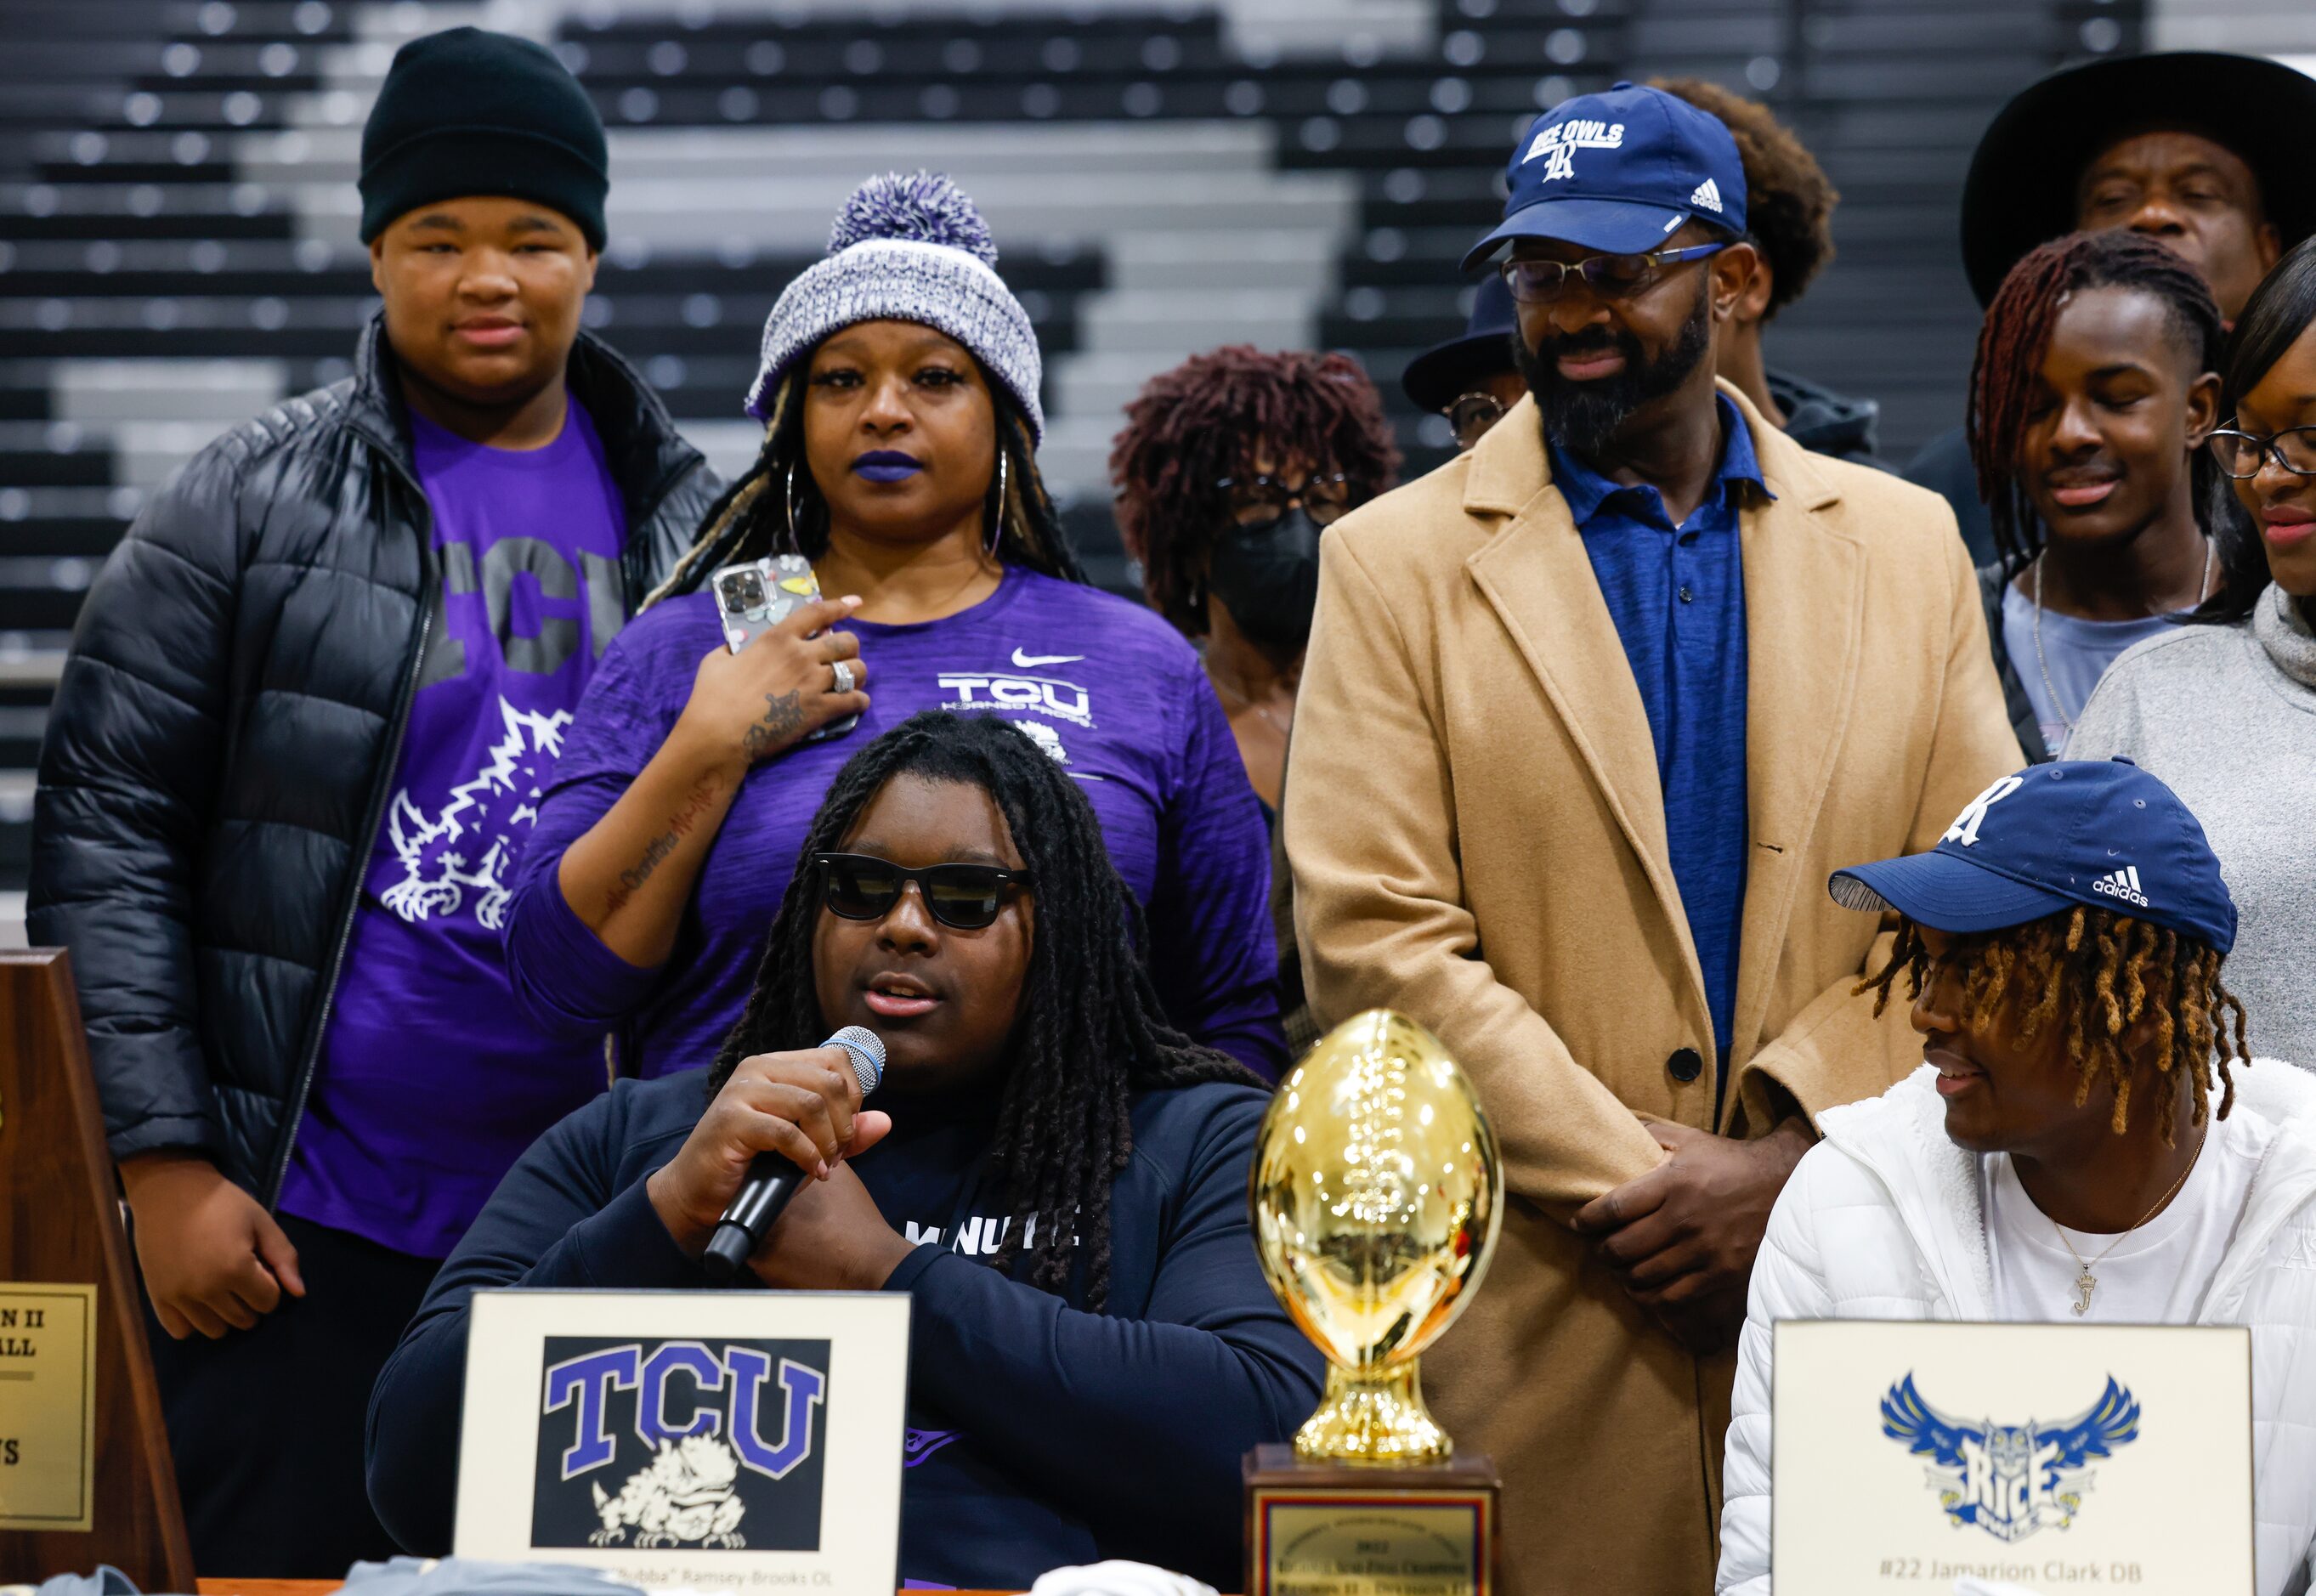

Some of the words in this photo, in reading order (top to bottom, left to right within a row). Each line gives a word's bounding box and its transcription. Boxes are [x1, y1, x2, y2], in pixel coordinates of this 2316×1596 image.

[1562, 119, 1625, 142] OWLS
[1542, 139, 1575, 184] R
[1690, 194, 1723, 213] adidas
[937, 678, 1090, 717] TCU
[1937, 775, 2024, 847] R
[2092, 879, 2149, 908] adidas
[543, 1341, 825, 1480] TCU
[1962, 1436, 2060, 1521] RICE
[1879, 1556, 1923, 1581] #22
[1928, 1558, 2036, 1582] Jamarion
[2042, 1558, 2103, 1583] Clark
[2109, 1560, 2143, 1585] DB
